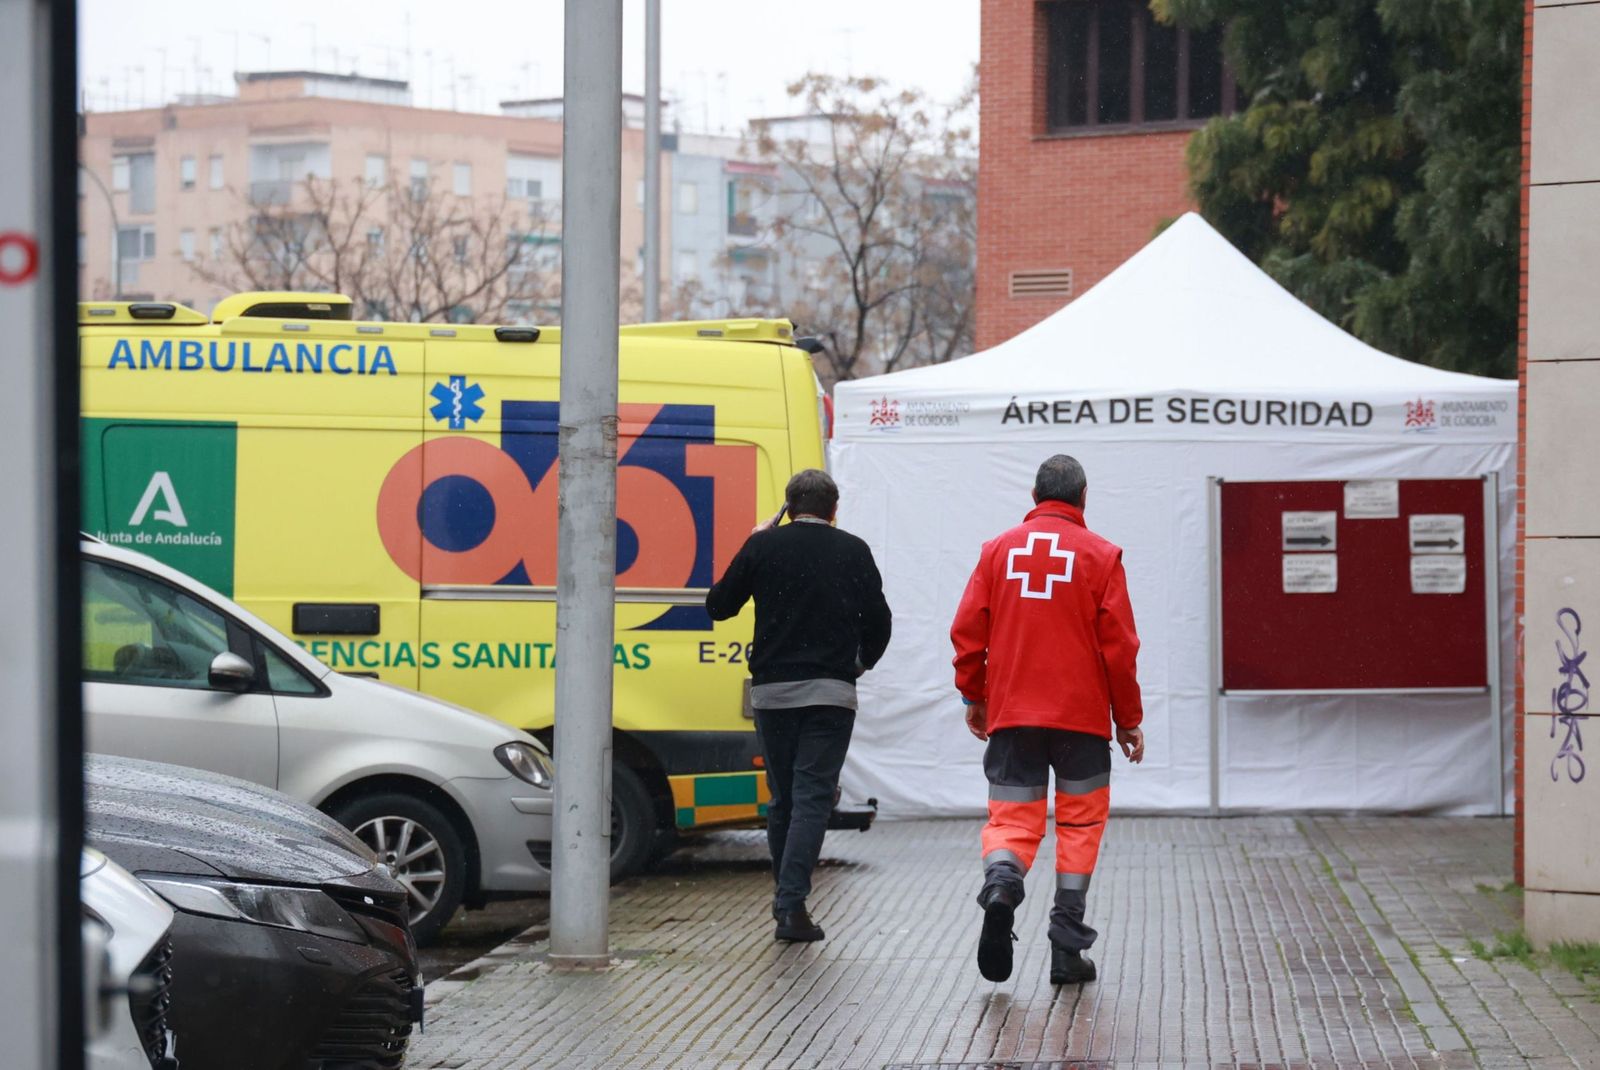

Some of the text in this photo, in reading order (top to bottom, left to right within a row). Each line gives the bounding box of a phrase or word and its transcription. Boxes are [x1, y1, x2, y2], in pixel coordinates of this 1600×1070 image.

[107, 339, 398, 376] AMBULANCIA
[905, 415, 916, 426] DE
[1001, 396, 1373, 427] ÁREA DE SEGURIDAD
[1441, 415, 1452, 427] DE
[136, 531, 152, 544] de
[155, 532, 222, 545] Andalucía
[294, 640, 651, 670] ENCIAS SANITAS
